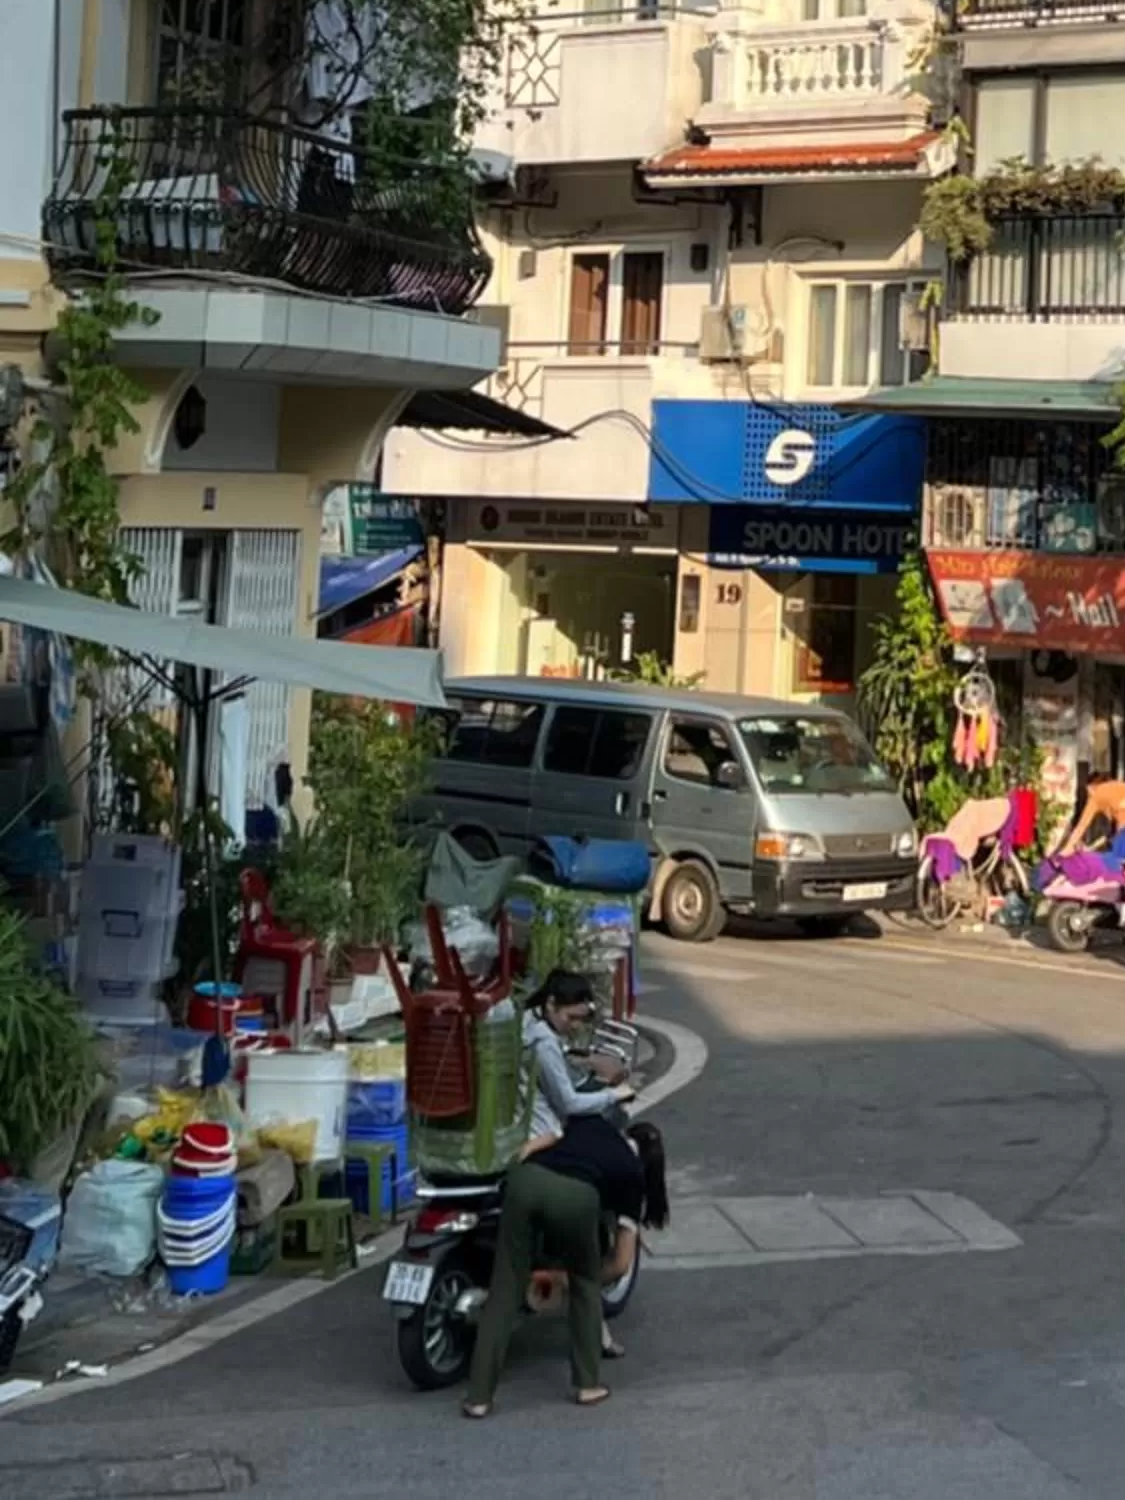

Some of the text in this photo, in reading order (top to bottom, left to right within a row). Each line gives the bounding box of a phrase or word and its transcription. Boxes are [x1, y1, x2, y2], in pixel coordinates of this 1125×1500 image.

[743, 520, 912, 556] SPOON HOTE
[715, 582, 741, 604] 19
